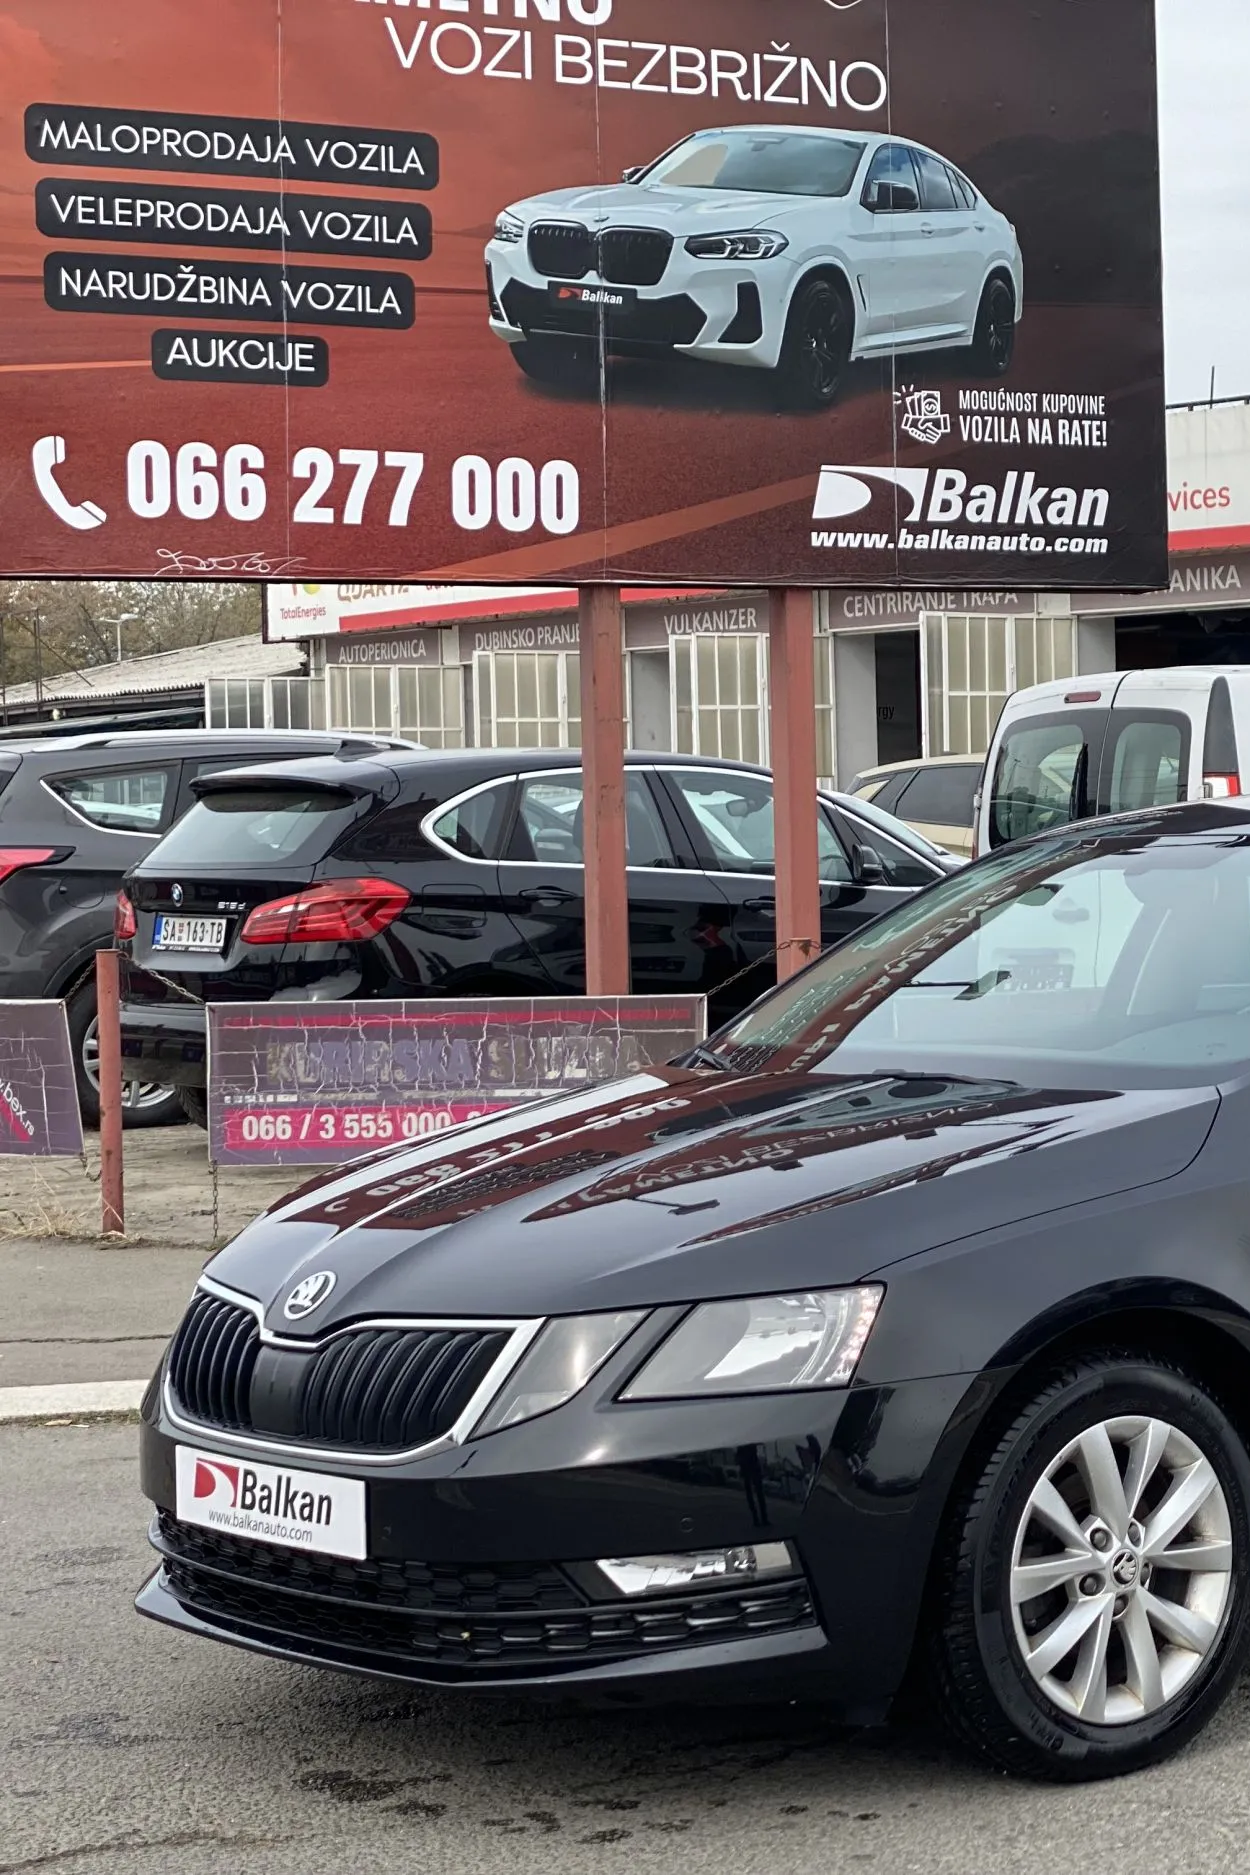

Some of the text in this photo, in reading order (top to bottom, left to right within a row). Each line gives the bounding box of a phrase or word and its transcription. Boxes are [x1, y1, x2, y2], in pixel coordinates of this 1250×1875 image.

[383, 16, 888, 112] VOZI BEZBRIŽNO
[38, 118, 426, 176] MALOPRODAJA VOZILA
[50, 192, 419, 246] VELEPRODAJA VOZILA
[59, 264, 402, 316] NARUDŽBINA VOZILA
[581, 288, 624, 305] Balkan
[165, 336, 316, 373] AUKCIJE
[958, 388, 1106, 416] MOGUĆNOST KUPOVINE
[959, 414, 1108, 447] VOZILA NA RATE!
[127, 439, 580, 535] 066 277 000
[926, 468, 1110, 527] Balkan
[1168, 481, 1232, 512] vices
[810, 528, 1109, 554] www.balkanauto.com
[1168, 564, 1242, 593] ANIKA
[279, 605, 327, 621] TotalEnergies
[663, 606, 757, 635] VULKANIZER
[843, 592, 957, 618] CENTRIRANJE
[338, 639, 428, 665] AUTOPERIONICA
[474, 628, 535, 652] DUBINSKO
[242, 1114, 293, 1141] 066
[319, 1113, 336, 1139] 3
[343, 1112, 394, 1139] 555
[240, 1468, 334, 1527] Balkan
[207, 1508, 314, 1544] www.balkanauto.com
